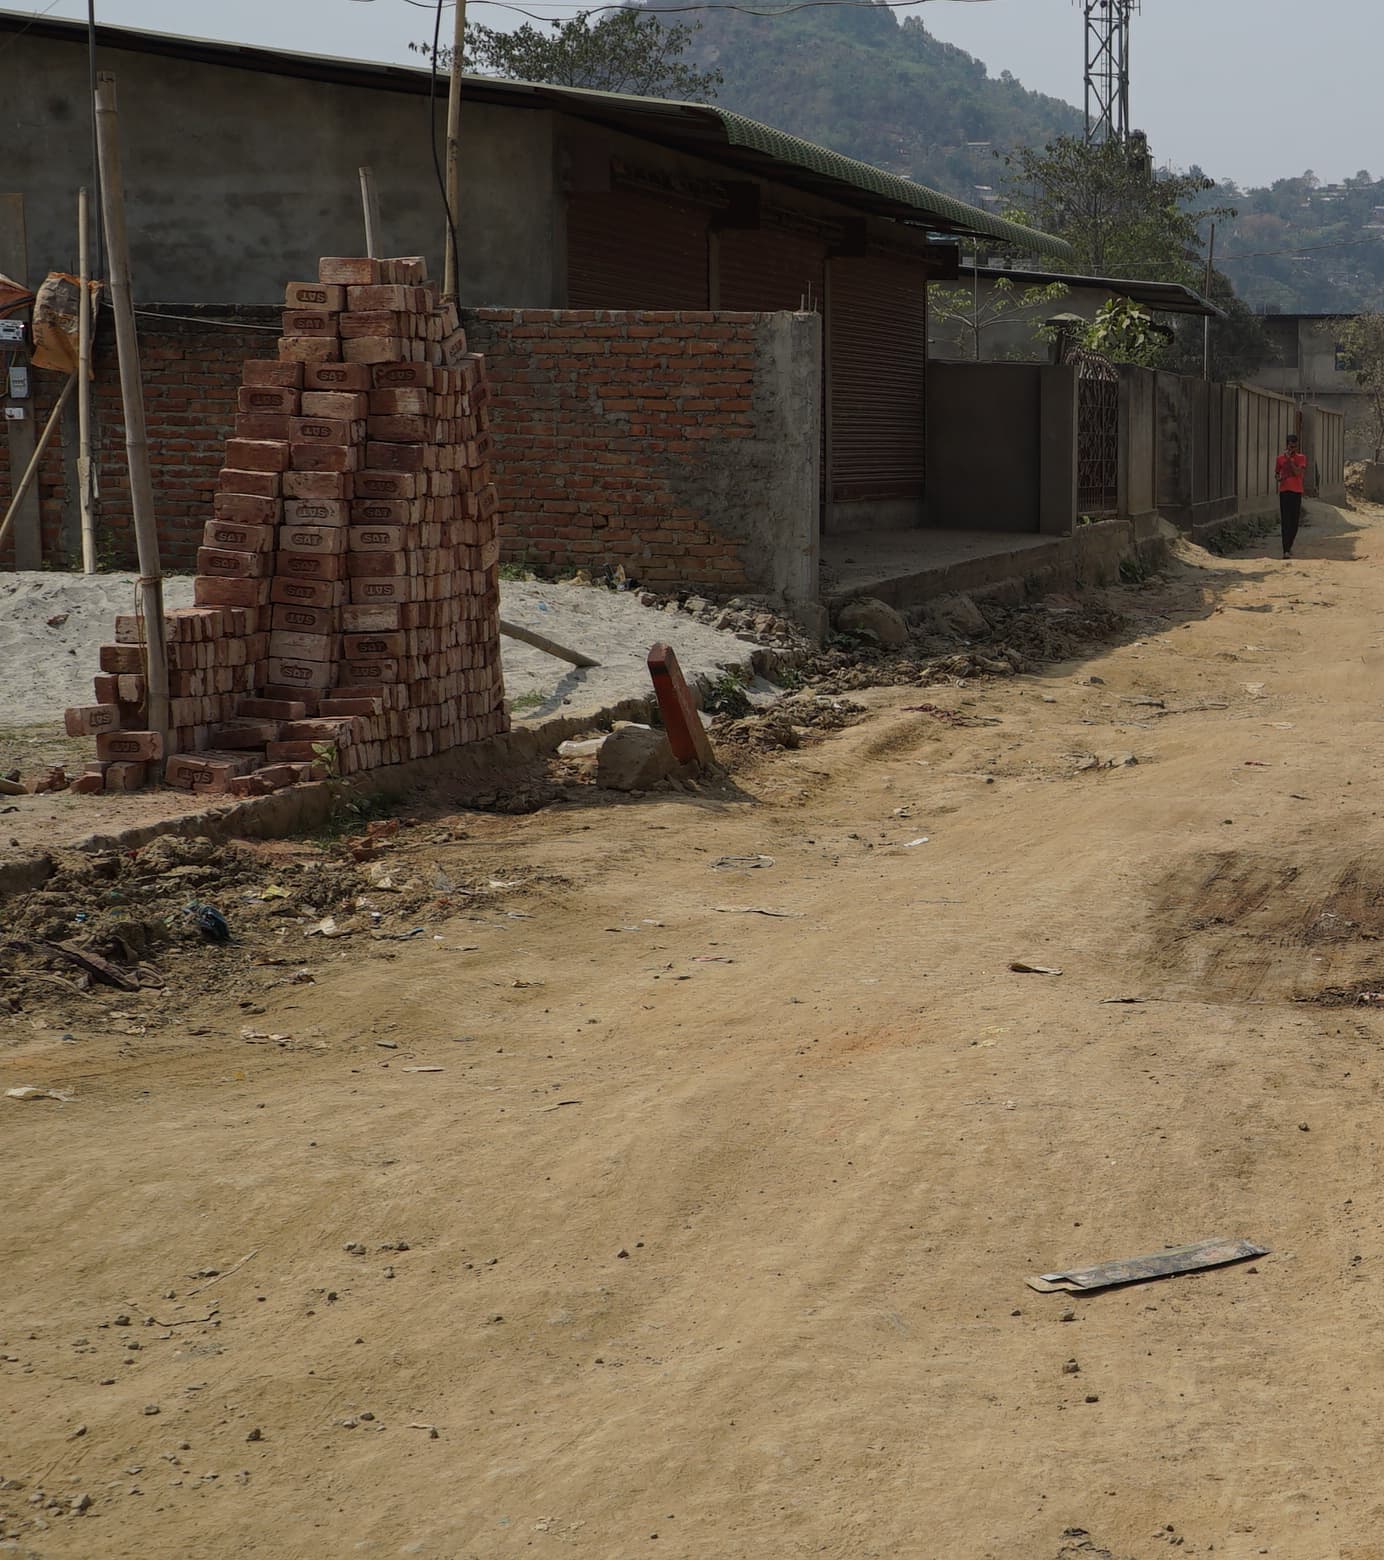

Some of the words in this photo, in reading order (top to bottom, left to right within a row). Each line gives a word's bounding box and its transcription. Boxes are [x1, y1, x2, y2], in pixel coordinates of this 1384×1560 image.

[300, 291, 326, 302] SAT
[297, 319, 322, 328] SAT
[319, 371, 346, 382] SAT
[218, 532, 244, 542] SAT
[294, 535, 320, 546] SAT
[363, 533, 387, 543] SAT
[213, 558, 239, 569] SAT
[288, 587, 314, 598] SAT
[284, 667, 311, 678] SAT
